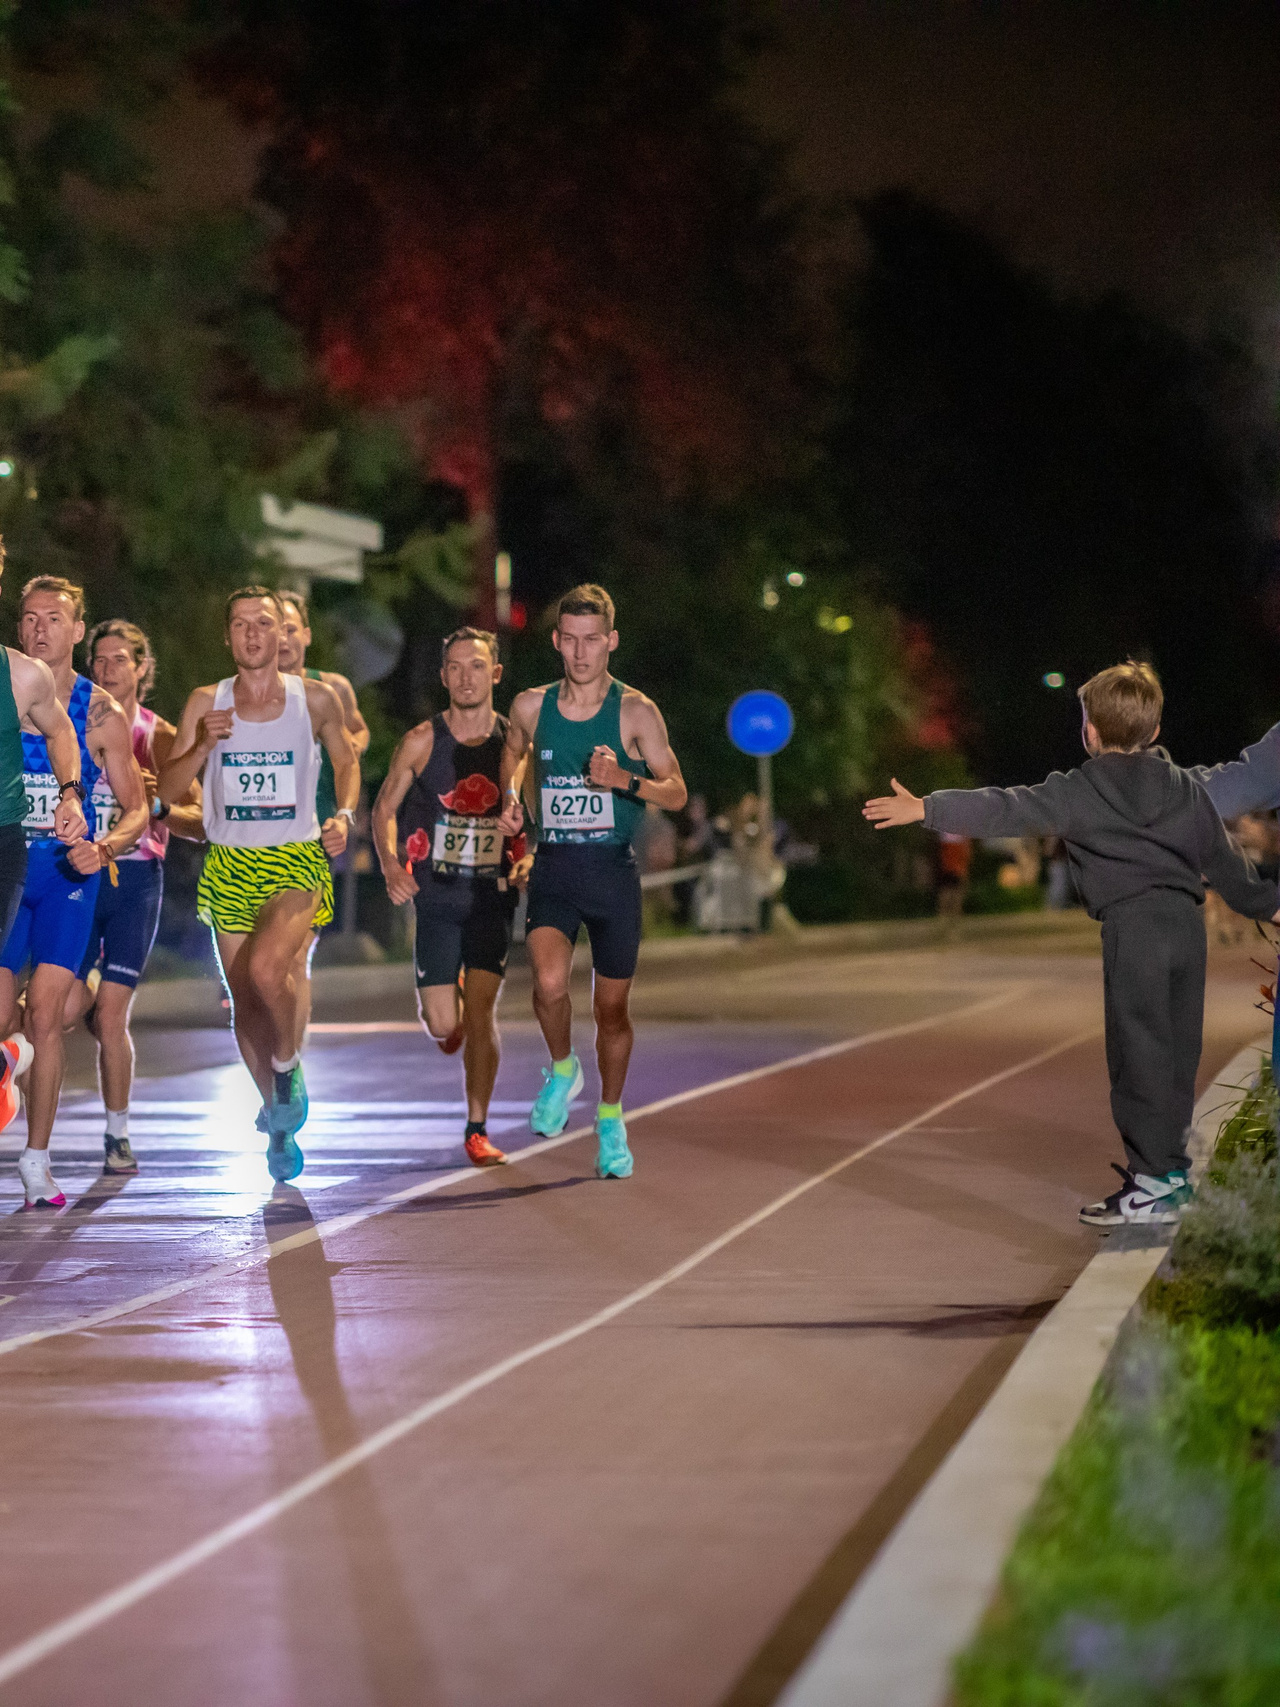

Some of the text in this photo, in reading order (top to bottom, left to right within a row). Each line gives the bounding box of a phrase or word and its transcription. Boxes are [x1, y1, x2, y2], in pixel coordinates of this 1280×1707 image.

[238, 772, 276, 793] 991
[550, 795, 603, 815] 6270
[443, 832, 494, 853] 8712
